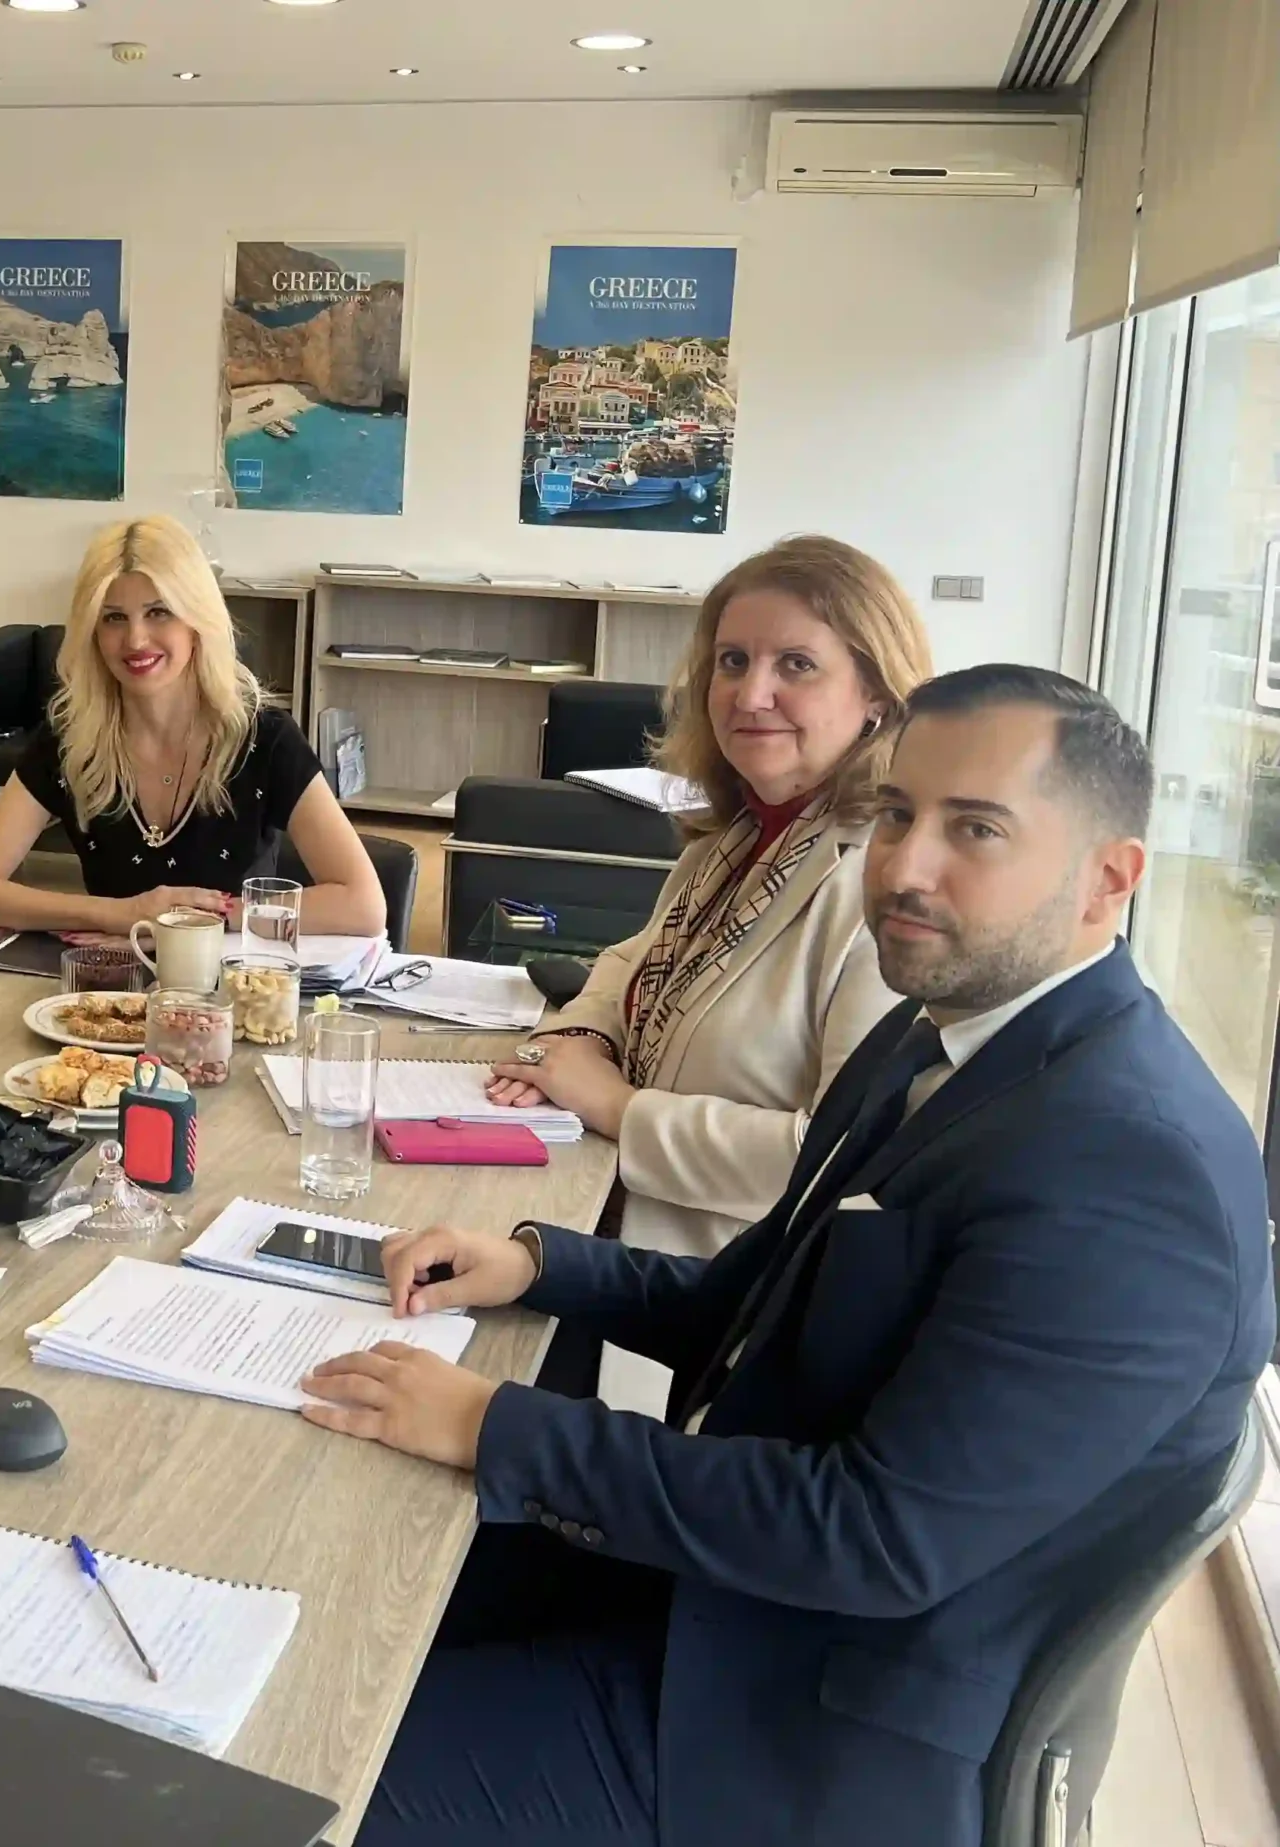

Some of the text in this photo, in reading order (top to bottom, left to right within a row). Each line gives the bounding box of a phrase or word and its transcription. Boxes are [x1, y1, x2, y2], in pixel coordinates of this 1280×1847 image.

[0, 266, 91, 287] GREECE
[272, 271, 371, 292] GREECE
[589, 276, 698, 299] GREECE
[612, 301, 629, 309] DAY
[632, 301, 696, 310] DESTINATION
